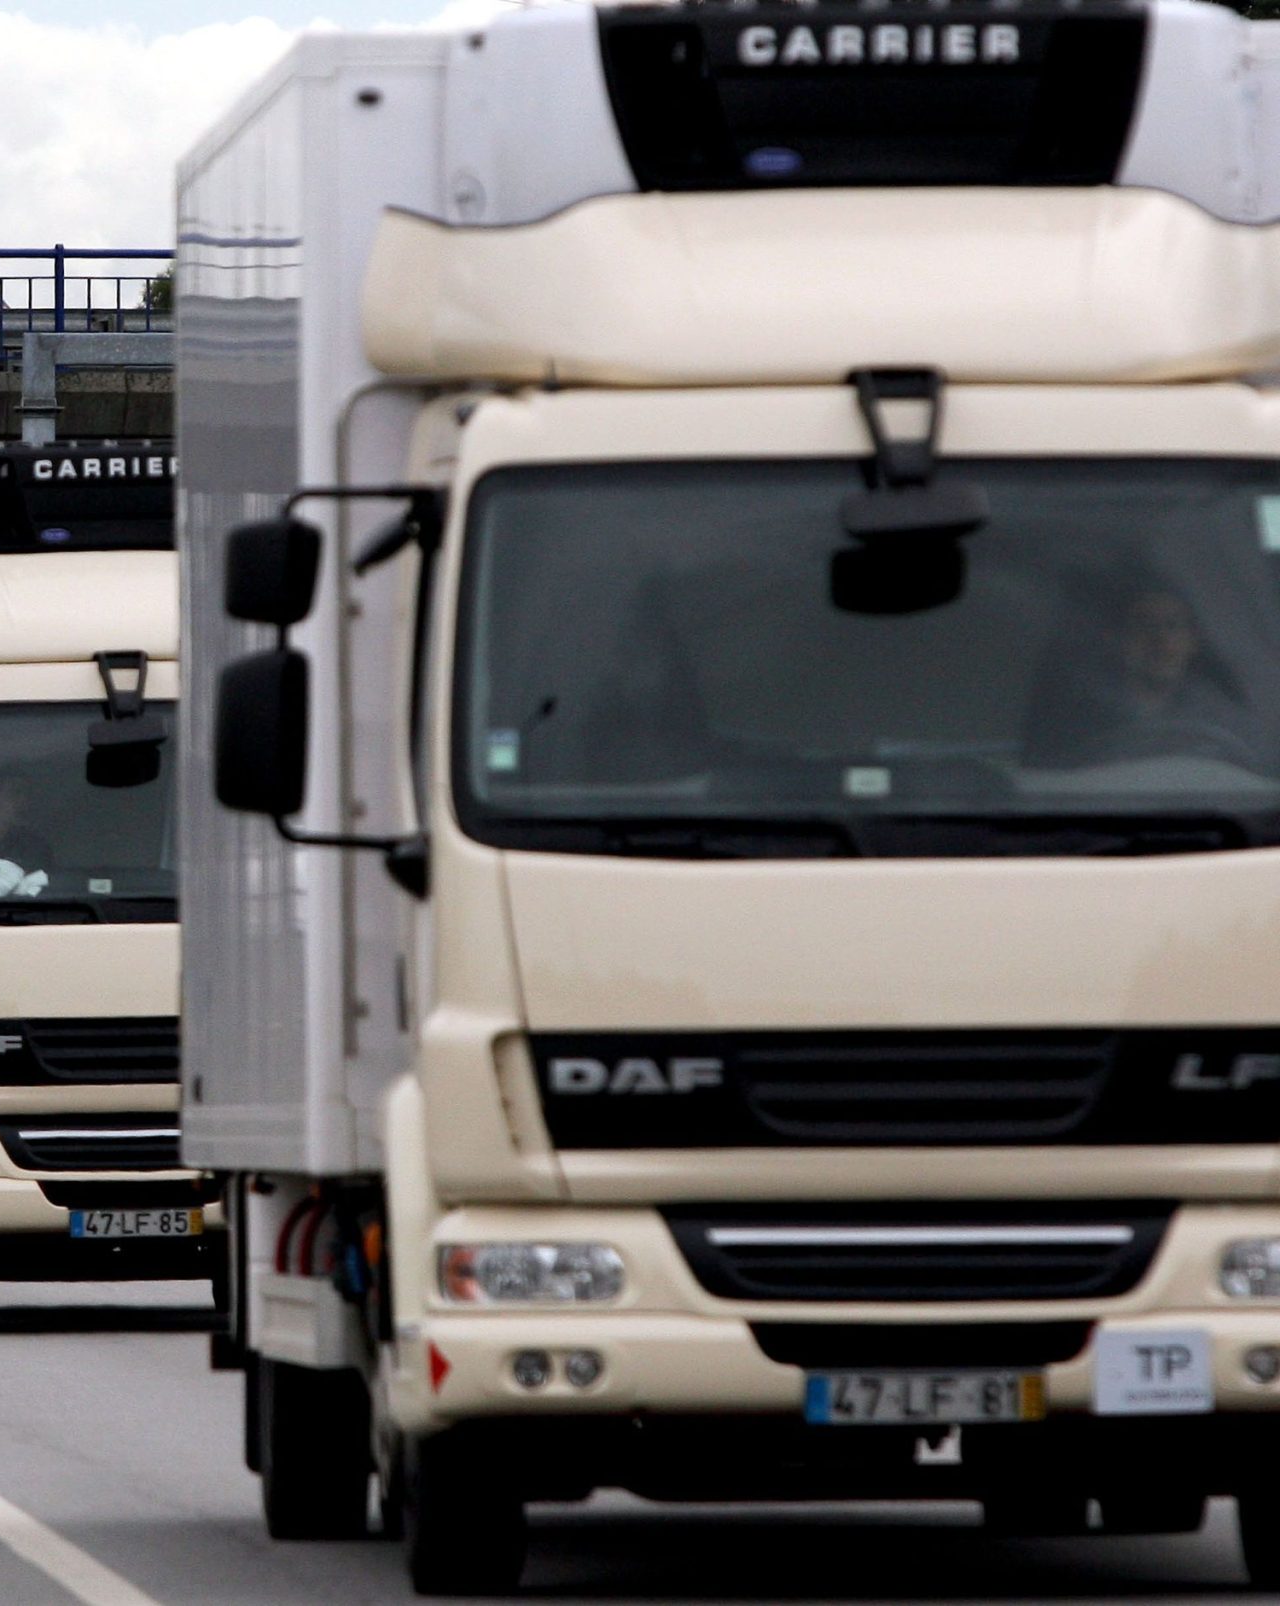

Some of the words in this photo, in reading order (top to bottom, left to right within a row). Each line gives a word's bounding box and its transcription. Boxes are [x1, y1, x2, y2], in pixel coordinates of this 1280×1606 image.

[738, 24, 1020, 66] CARRIER
[549, 1057, 724, 1096] DAF
[1134, 1343, 1193, 1379] TP
